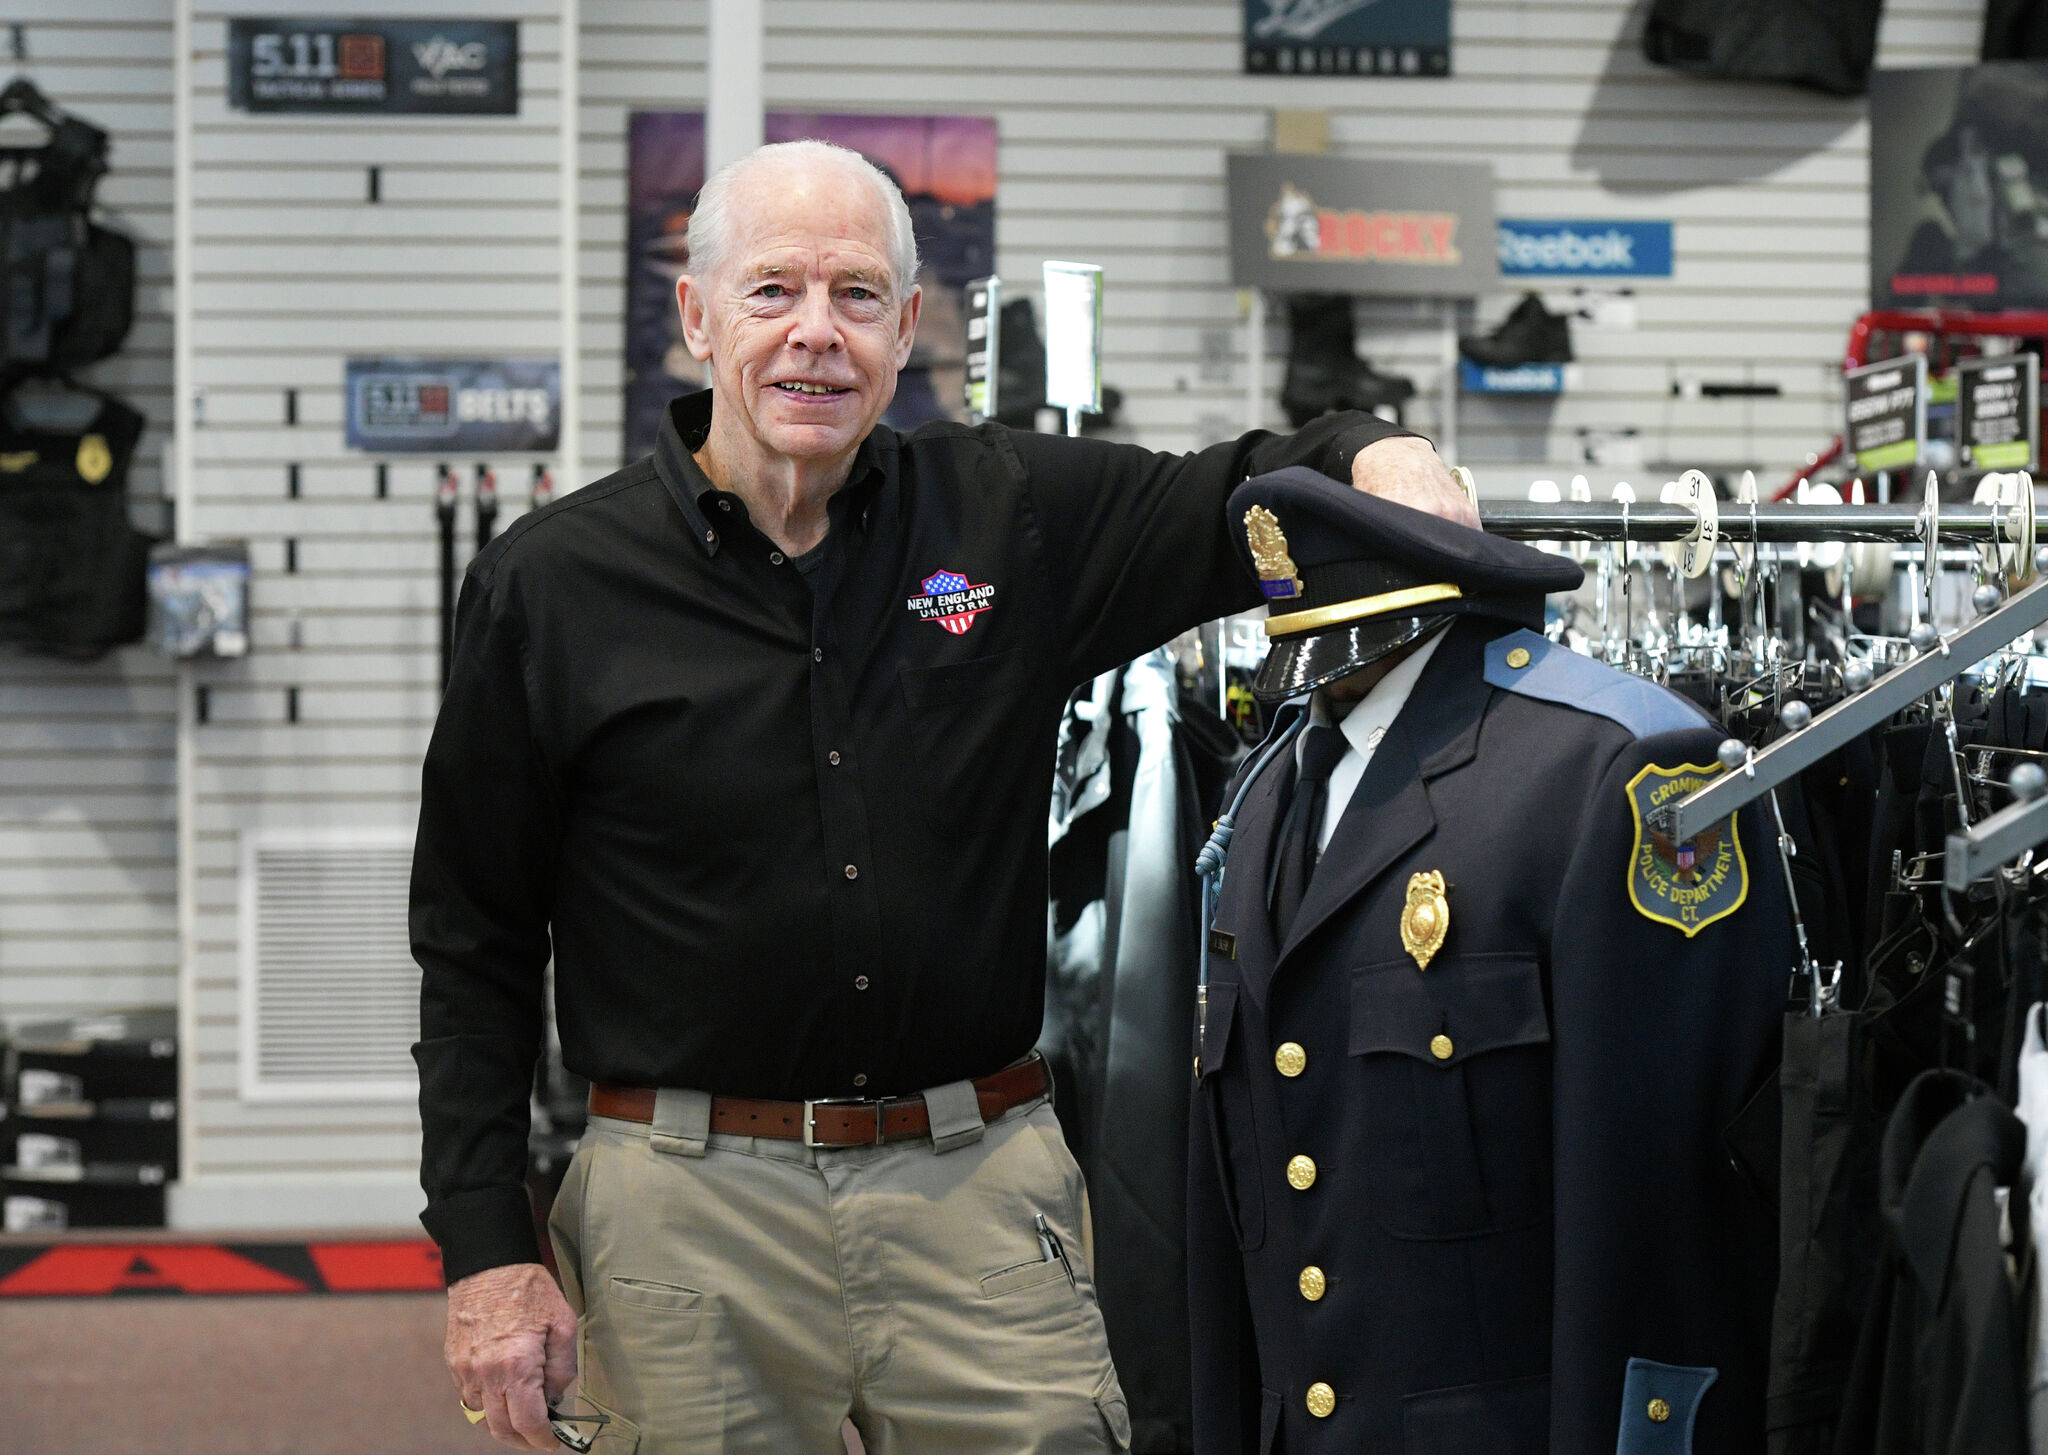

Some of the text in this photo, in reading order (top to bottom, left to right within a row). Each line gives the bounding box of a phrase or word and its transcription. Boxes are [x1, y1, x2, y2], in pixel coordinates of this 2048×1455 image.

[1317, 209, 1456, 258] ROCKY
[457, 387, 551, 435] BELTS
[1689, 477, 1701, 498] 31
[1703, 519, 1713, 542] 31
[1683, 550, 1694, 572] 31
[907, 585, 995, 610] NEW ENGLAND
[920, 598, 990, 618] UNIFORM
[1640, 840, 1733, 905] POLICE DEPARTMENT
